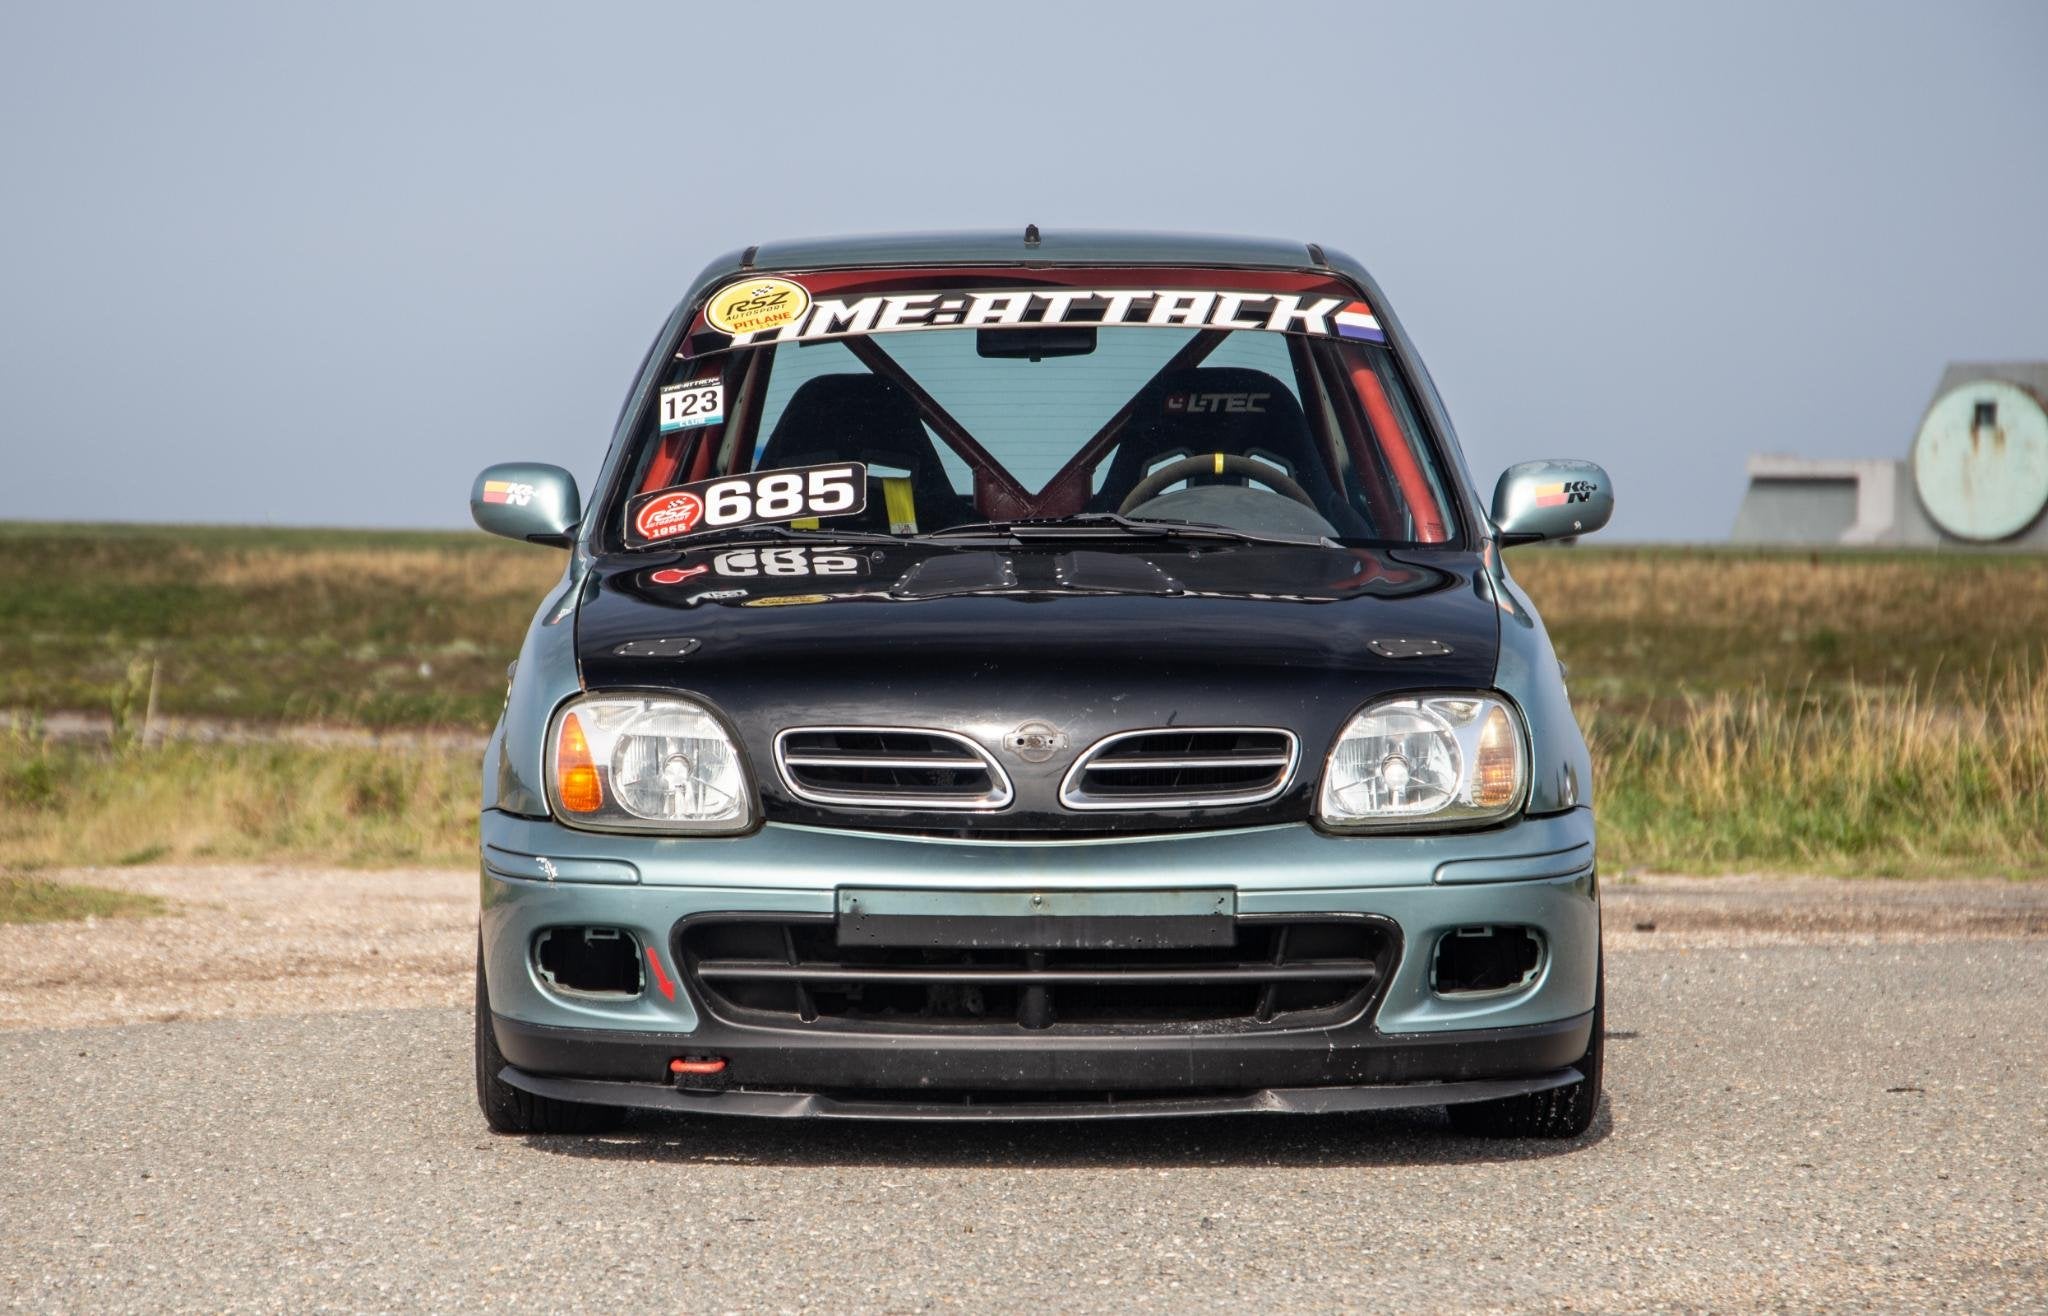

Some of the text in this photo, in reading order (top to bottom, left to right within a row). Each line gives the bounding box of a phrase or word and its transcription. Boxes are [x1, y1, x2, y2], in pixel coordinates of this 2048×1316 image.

[726, 291, 790, 316] RSZ
[726, 305, 785, 321] AUTOSPORT
[733, 311, 792, 331] PITLANE
[665, 390, 717, 420] 123
[705, 468, 854, 526] 685
[1563, 481, 1597, 504] K&N
